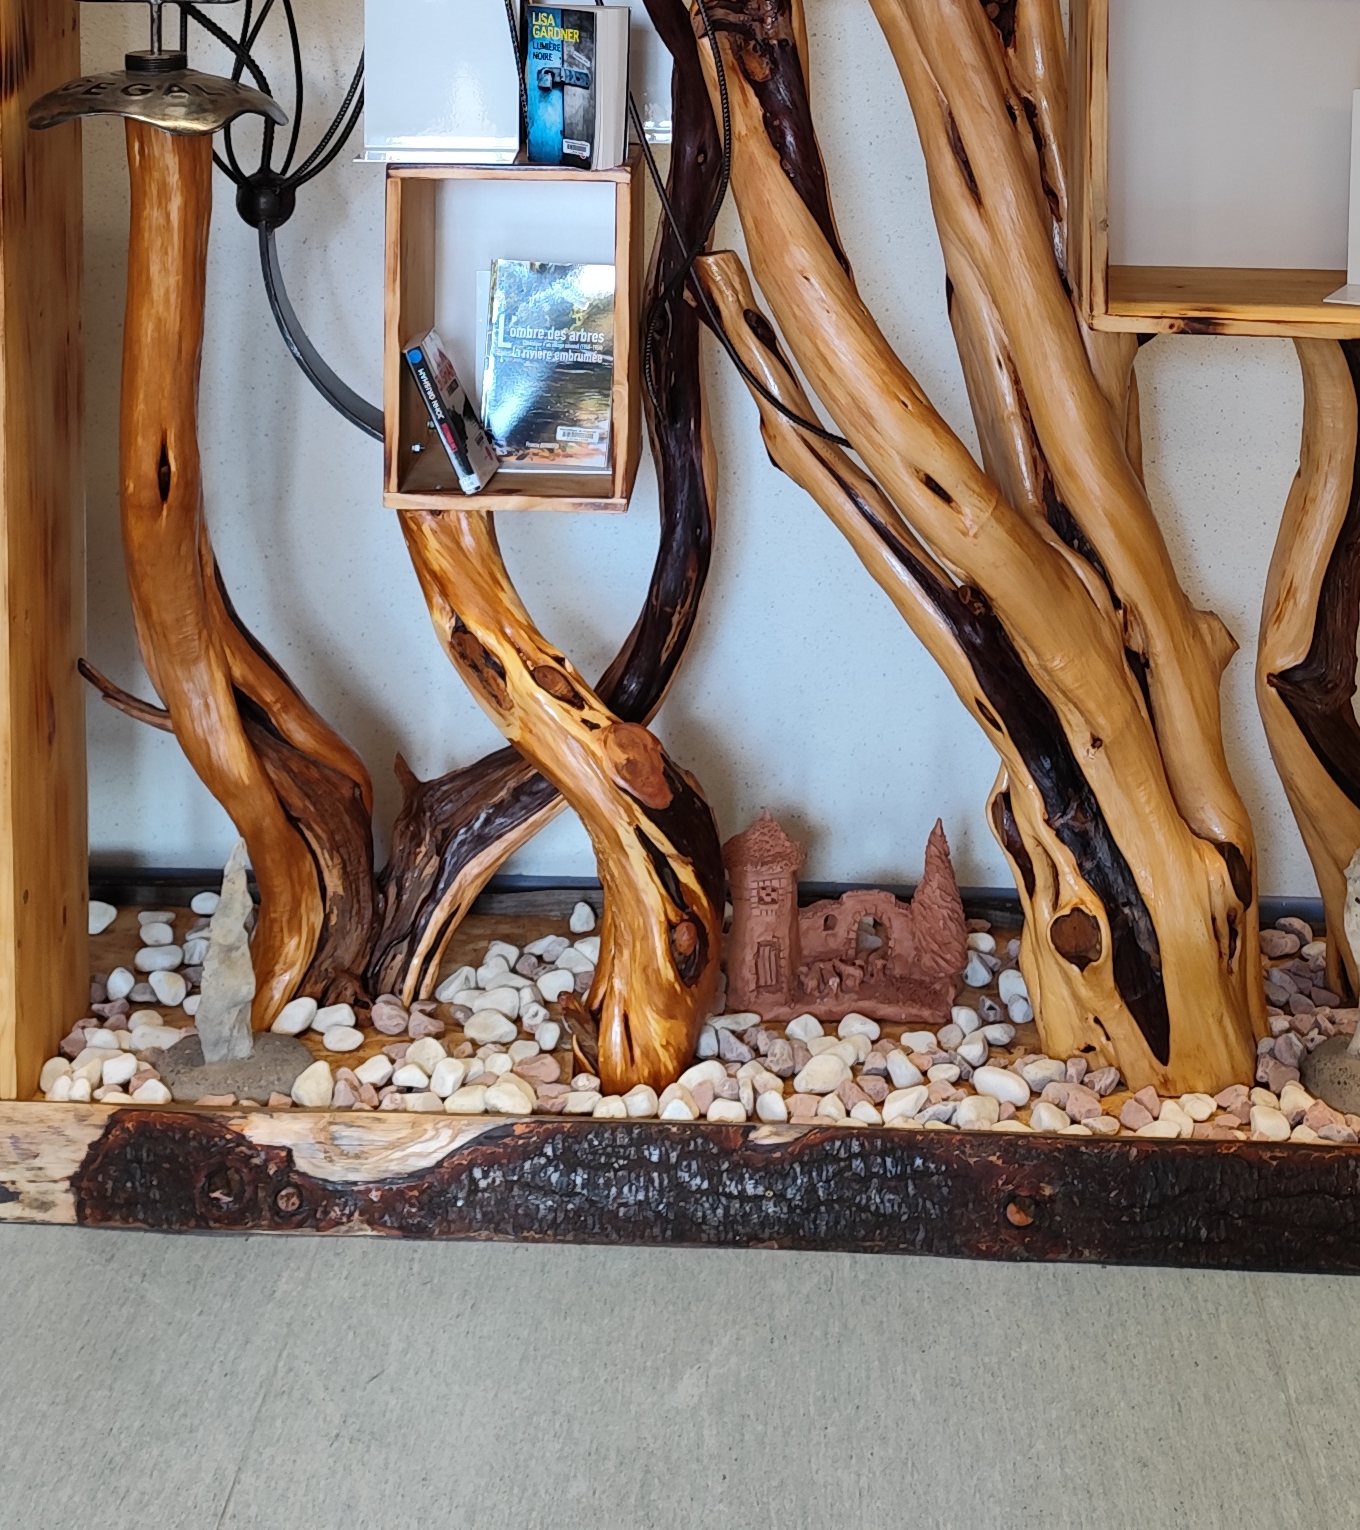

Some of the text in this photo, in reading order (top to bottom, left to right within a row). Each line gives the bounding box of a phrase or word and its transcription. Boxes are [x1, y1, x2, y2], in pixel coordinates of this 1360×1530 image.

[532, 12, 555, 27] LISA
[532, 25, 579, 43] GARDNER
[532, 40, 561, 53] LUMIÈRE
[532, 50, 554, 62] NOIRE
[548, 327, 568, 341] des
[568, 328, 605, 343] arbres
[554, 349, 603, 364] embrumée
[417, 367, 445, 420] JOHN GRISHAM
